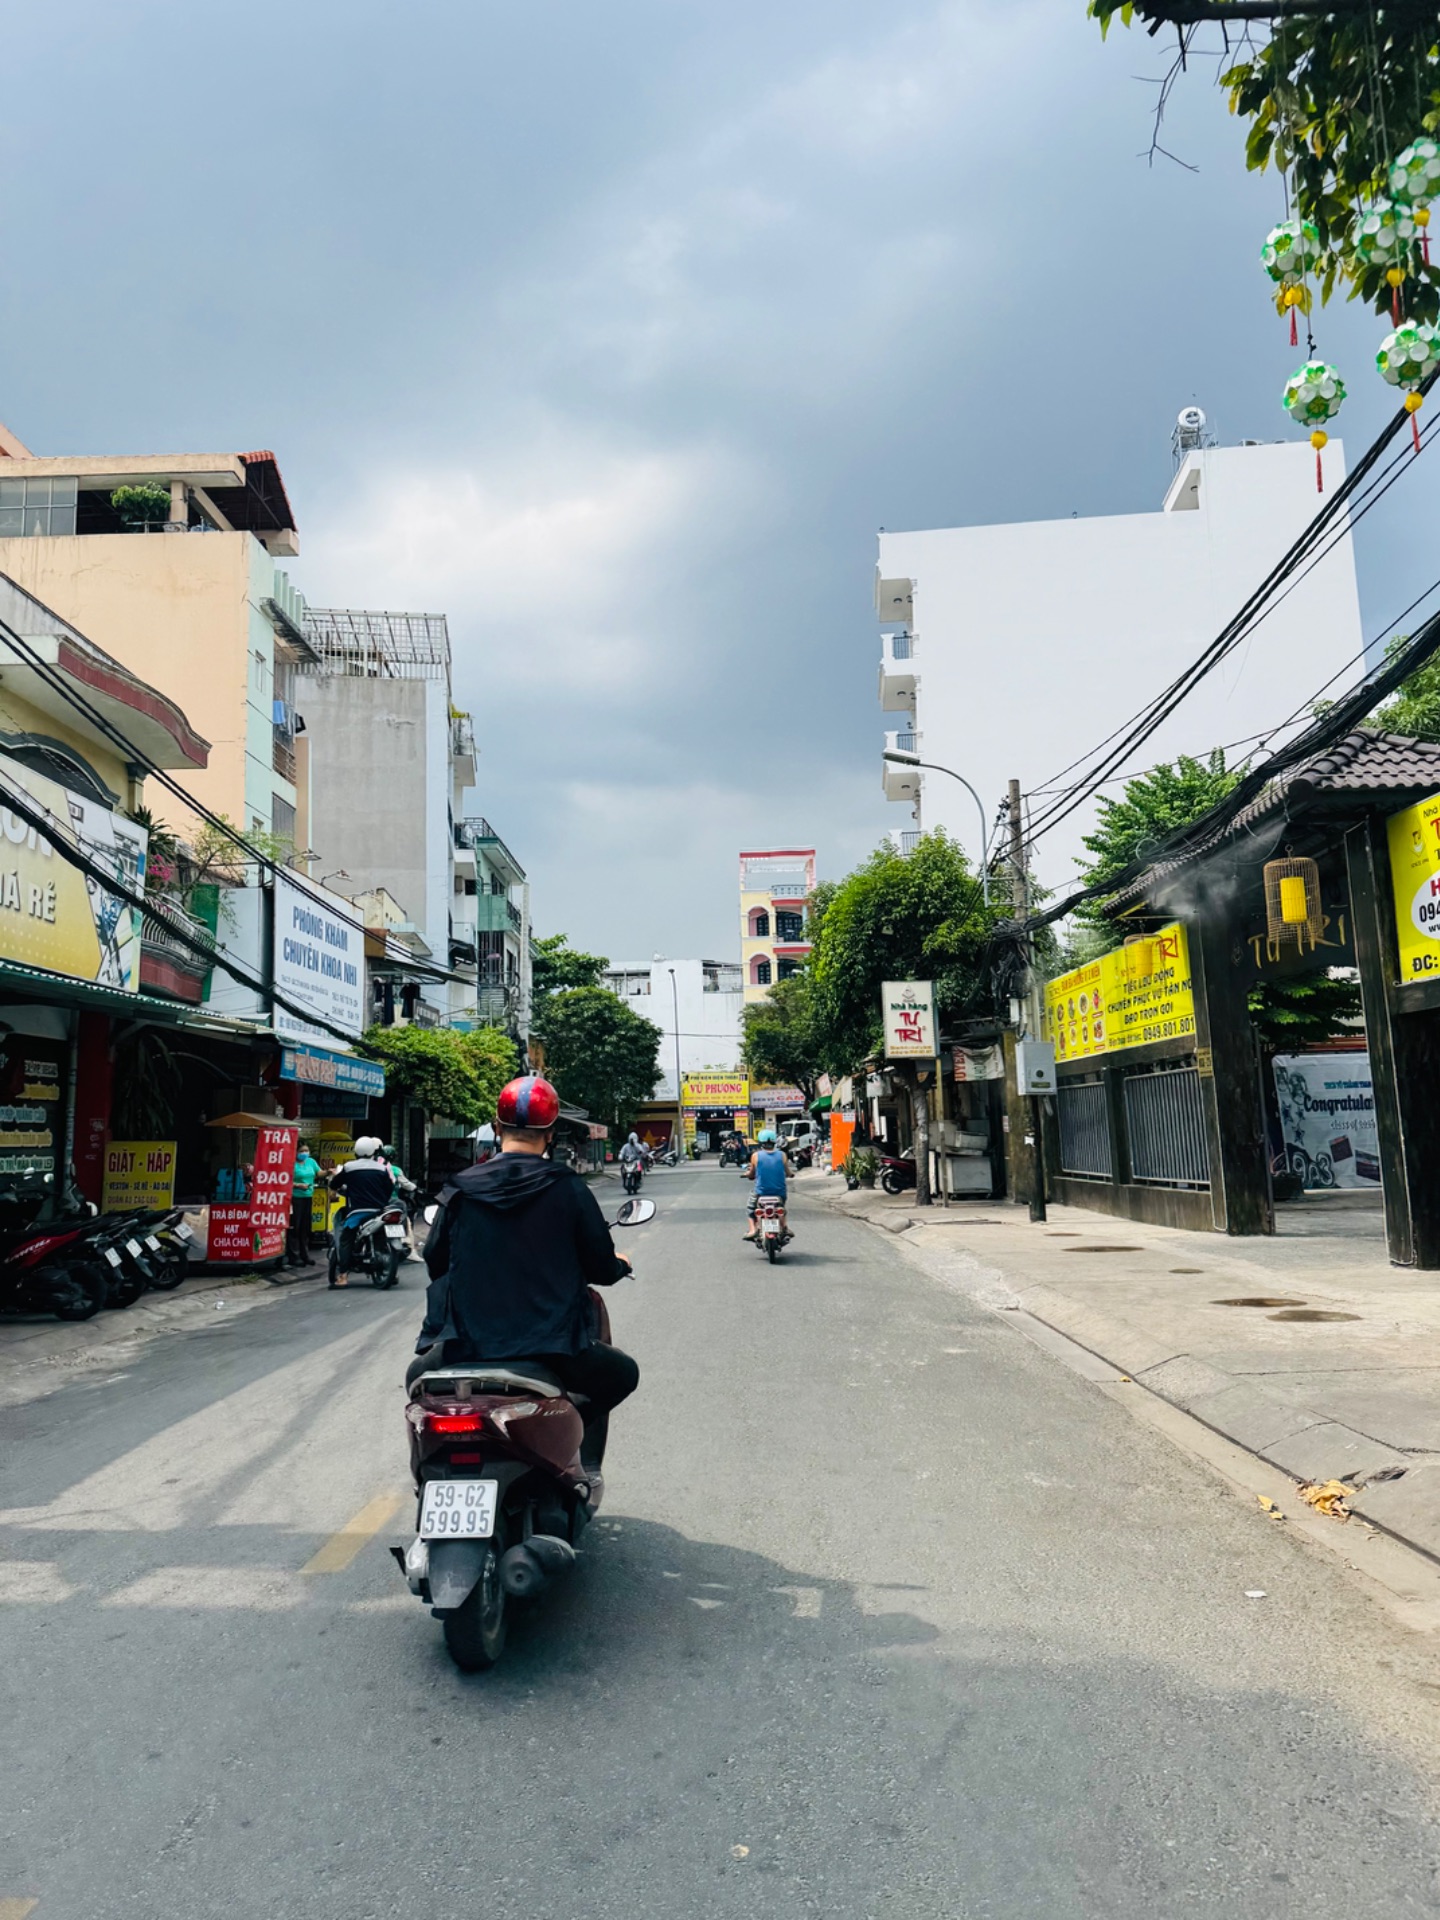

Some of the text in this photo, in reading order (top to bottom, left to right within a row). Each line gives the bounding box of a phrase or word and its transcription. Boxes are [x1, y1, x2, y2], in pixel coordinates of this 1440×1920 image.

[29, 880, 56, 924] RẺ
[292, 905, 348, 952] PHÒNG KHÁM
[283, 936, 357, 987] CHUYÊN KHOA NHI
[1412, 954, 1439, 972] ĐC:
[264, 1129, 291, 1144] TRÀ
[108, 1145, 171, 1177] GIẶT HẤP
[268, 1149, 284, 1164] BÍ
[257, 1171, 290, 1185] ĐAO
[256, 1192, 287, 1209] HẠT
[212, 1209, 227, 1220] TRÀ
[227, 1208, 236, 1219] BÍ
[251, 1212, 287, 1226] CHIA
[224, 1224, 239, 1236] HẠT
[213, 1237, 250, 1248] CHIA CHIA
[434, 1485, 486, 1508] 59-G2
[425, 1509, 490, 1534] 599.95
